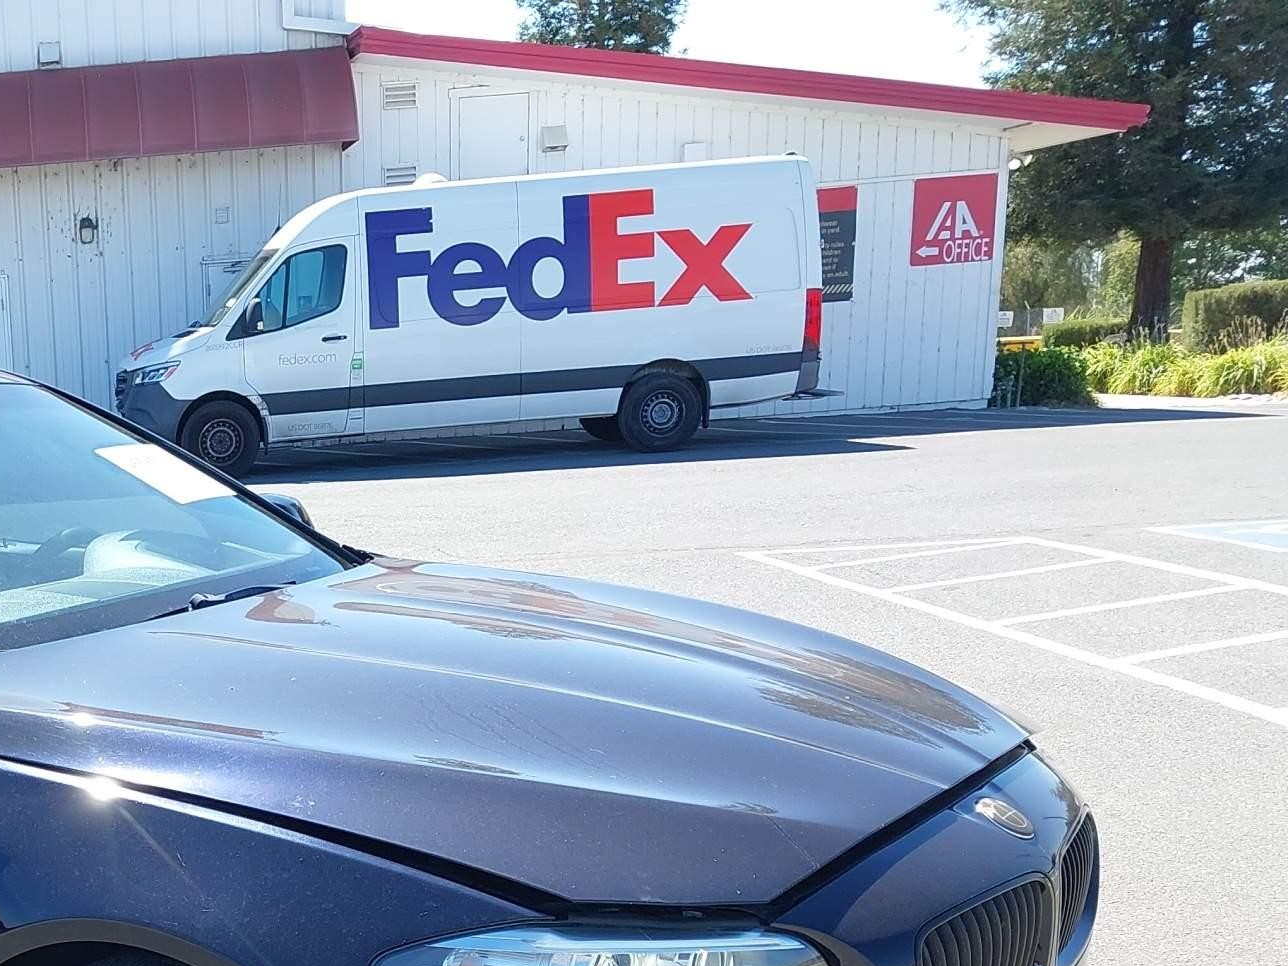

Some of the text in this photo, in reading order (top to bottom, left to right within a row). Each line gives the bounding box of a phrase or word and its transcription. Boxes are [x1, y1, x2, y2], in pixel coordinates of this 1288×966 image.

[364, 188, 754, 331] FedEx
[943, 238, 991, 262] OFFICE
[278, 353, 338, 366] fedex.com
